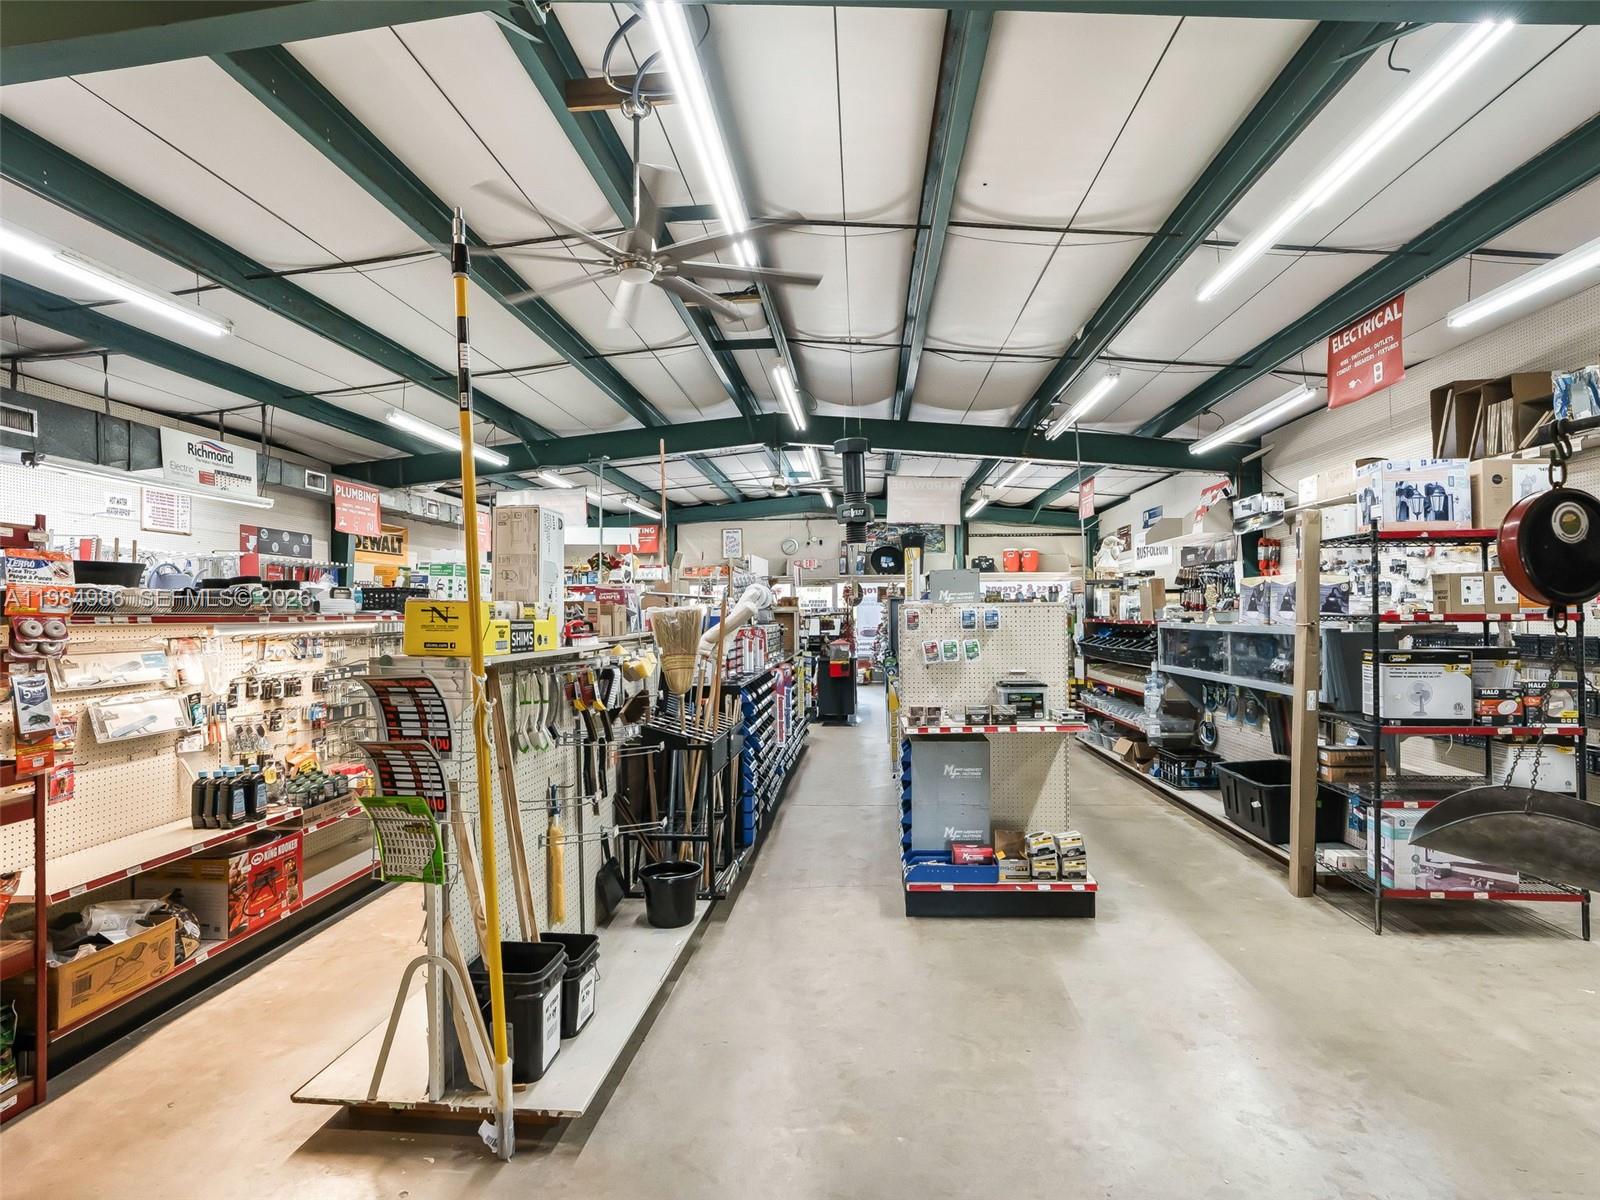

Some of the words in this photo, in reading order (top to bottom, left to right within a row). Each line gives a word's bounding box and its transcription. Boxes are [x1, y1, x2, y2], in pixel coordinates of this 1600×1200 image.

[1332, 303, 1402, 354] ELECTRICAL
[187, 442, 234, 464] Richmond
[169, 460, 194, 474] Electric
[335, 485, 377, 504] PLUMBING
[511, 631, 533, 647] SHIMS
